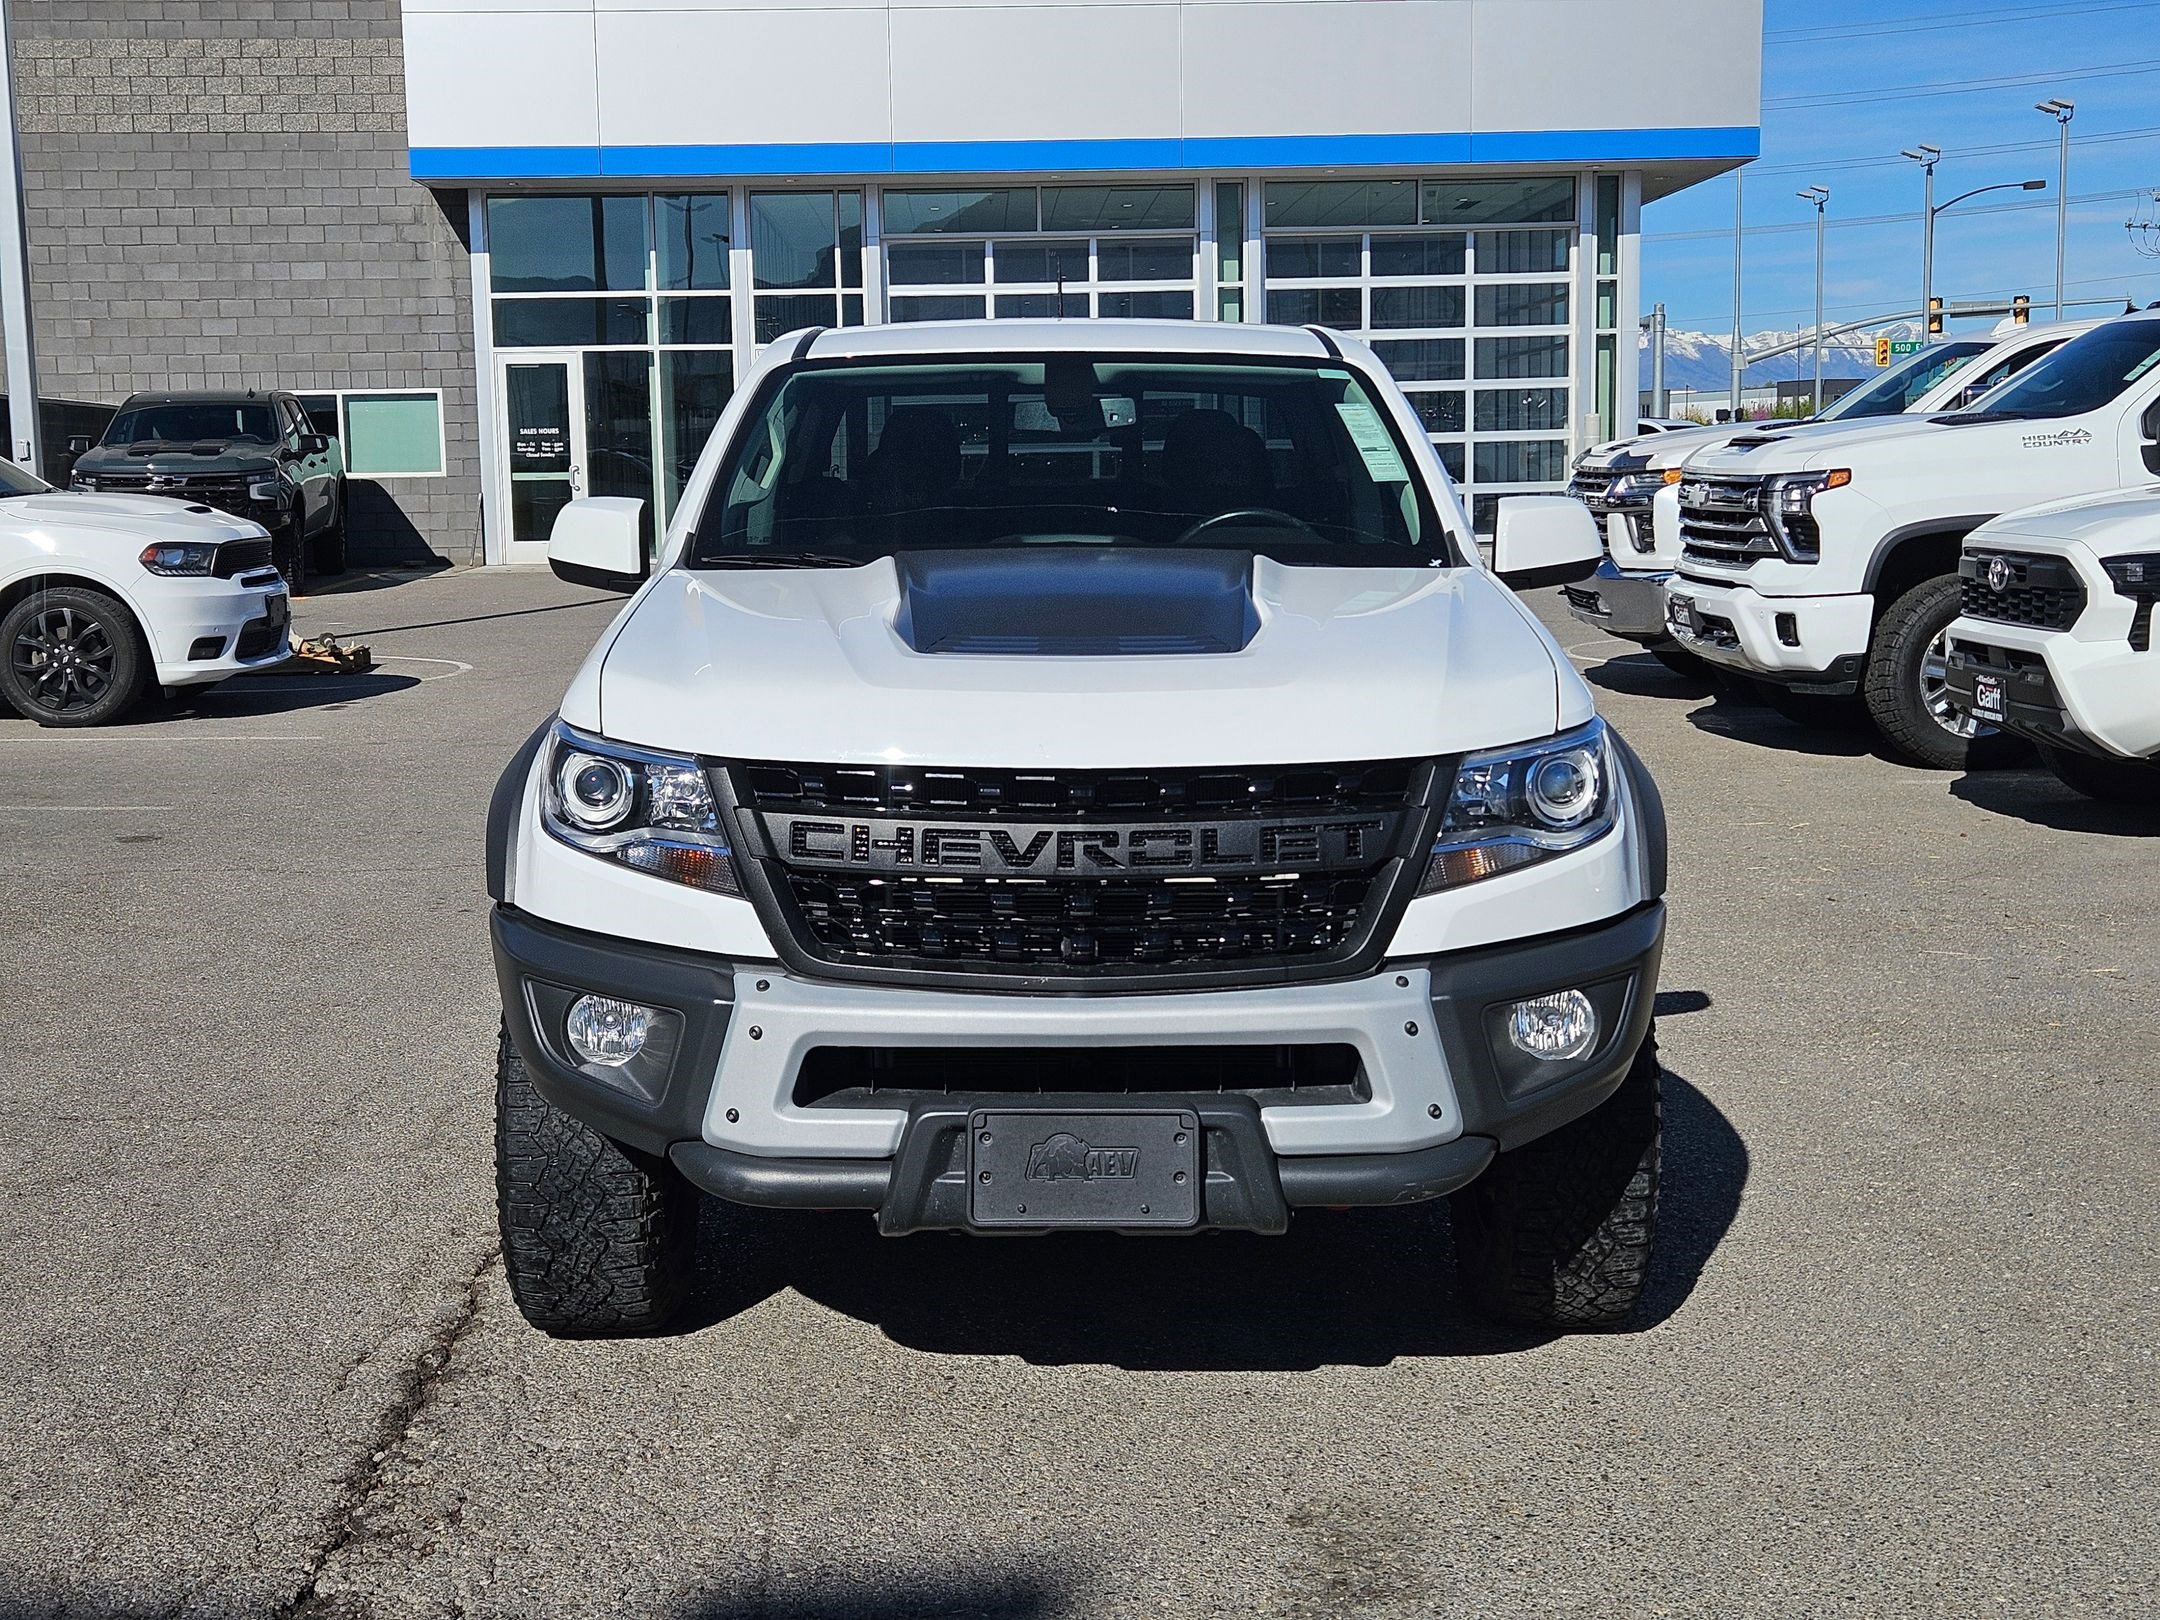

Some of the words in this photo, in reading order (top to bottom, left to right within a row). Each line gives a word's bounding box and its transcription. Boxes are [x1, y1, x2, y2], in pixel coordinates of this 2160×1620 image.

[1895, 343, 1911, 352] 500
[2023, 438, 2091, 448] COUNTRY
[789, 819, 1386, 871] CHEVROLET
[1086, 1151, 1134, 1176] AEV
